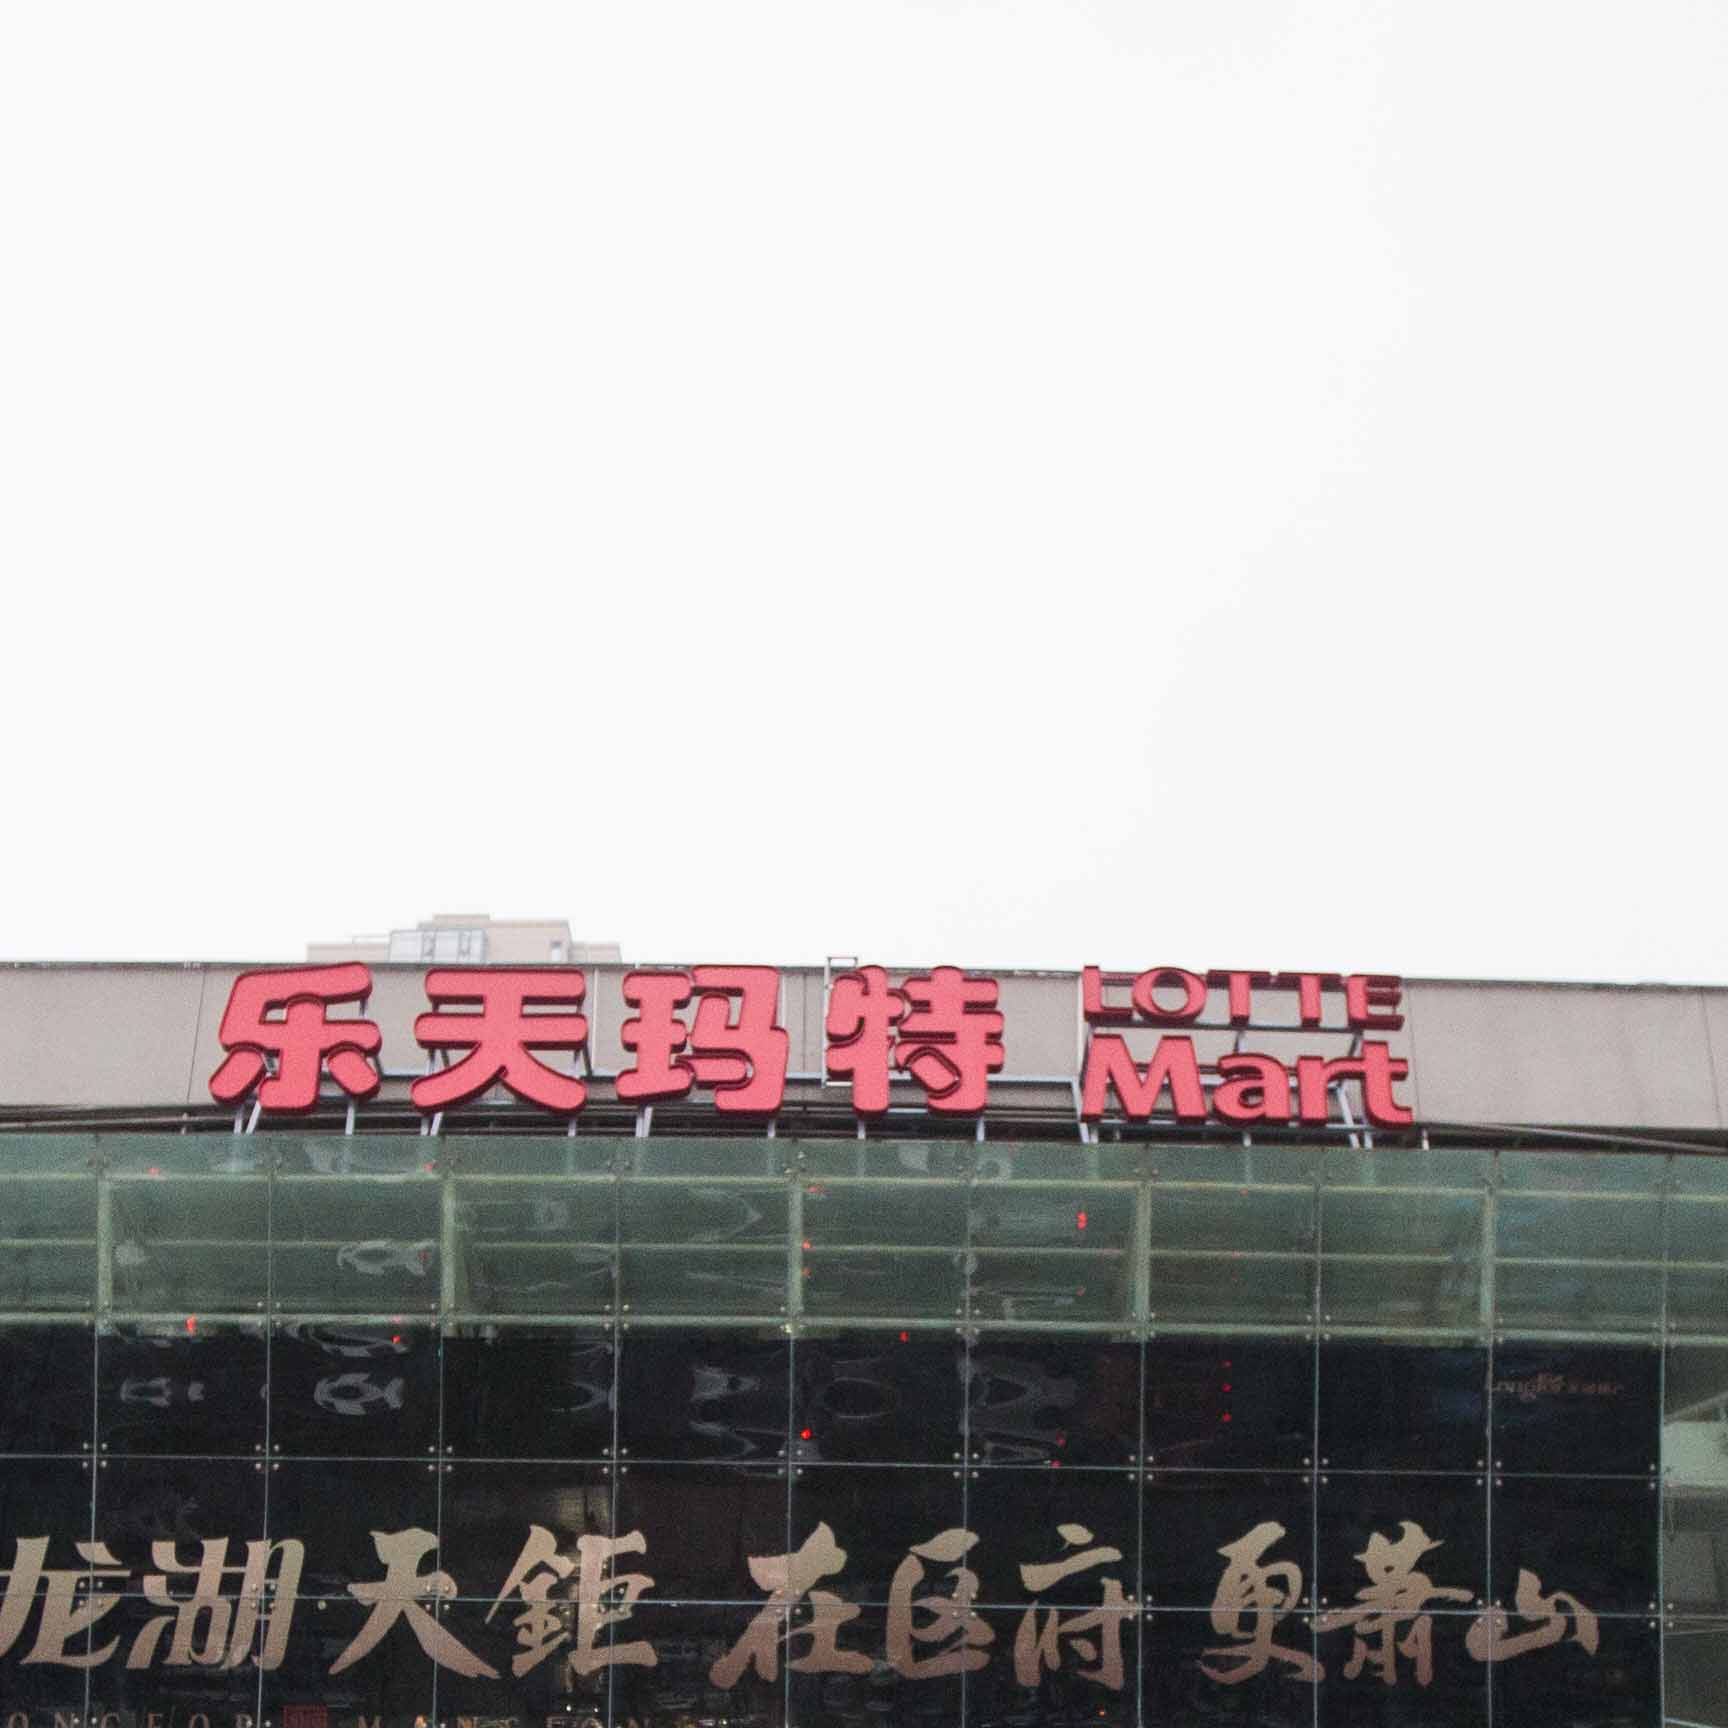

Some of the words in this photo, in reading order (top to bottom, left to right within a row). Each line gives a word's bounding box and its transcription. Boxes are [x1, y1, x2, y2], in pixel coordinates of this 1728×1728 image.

[209, 961, 1006, 1117] 乐天玛特
[1080, 964, 1406, 1030] LOTTE
[1077, 1033, 1415, 1129] Mart
